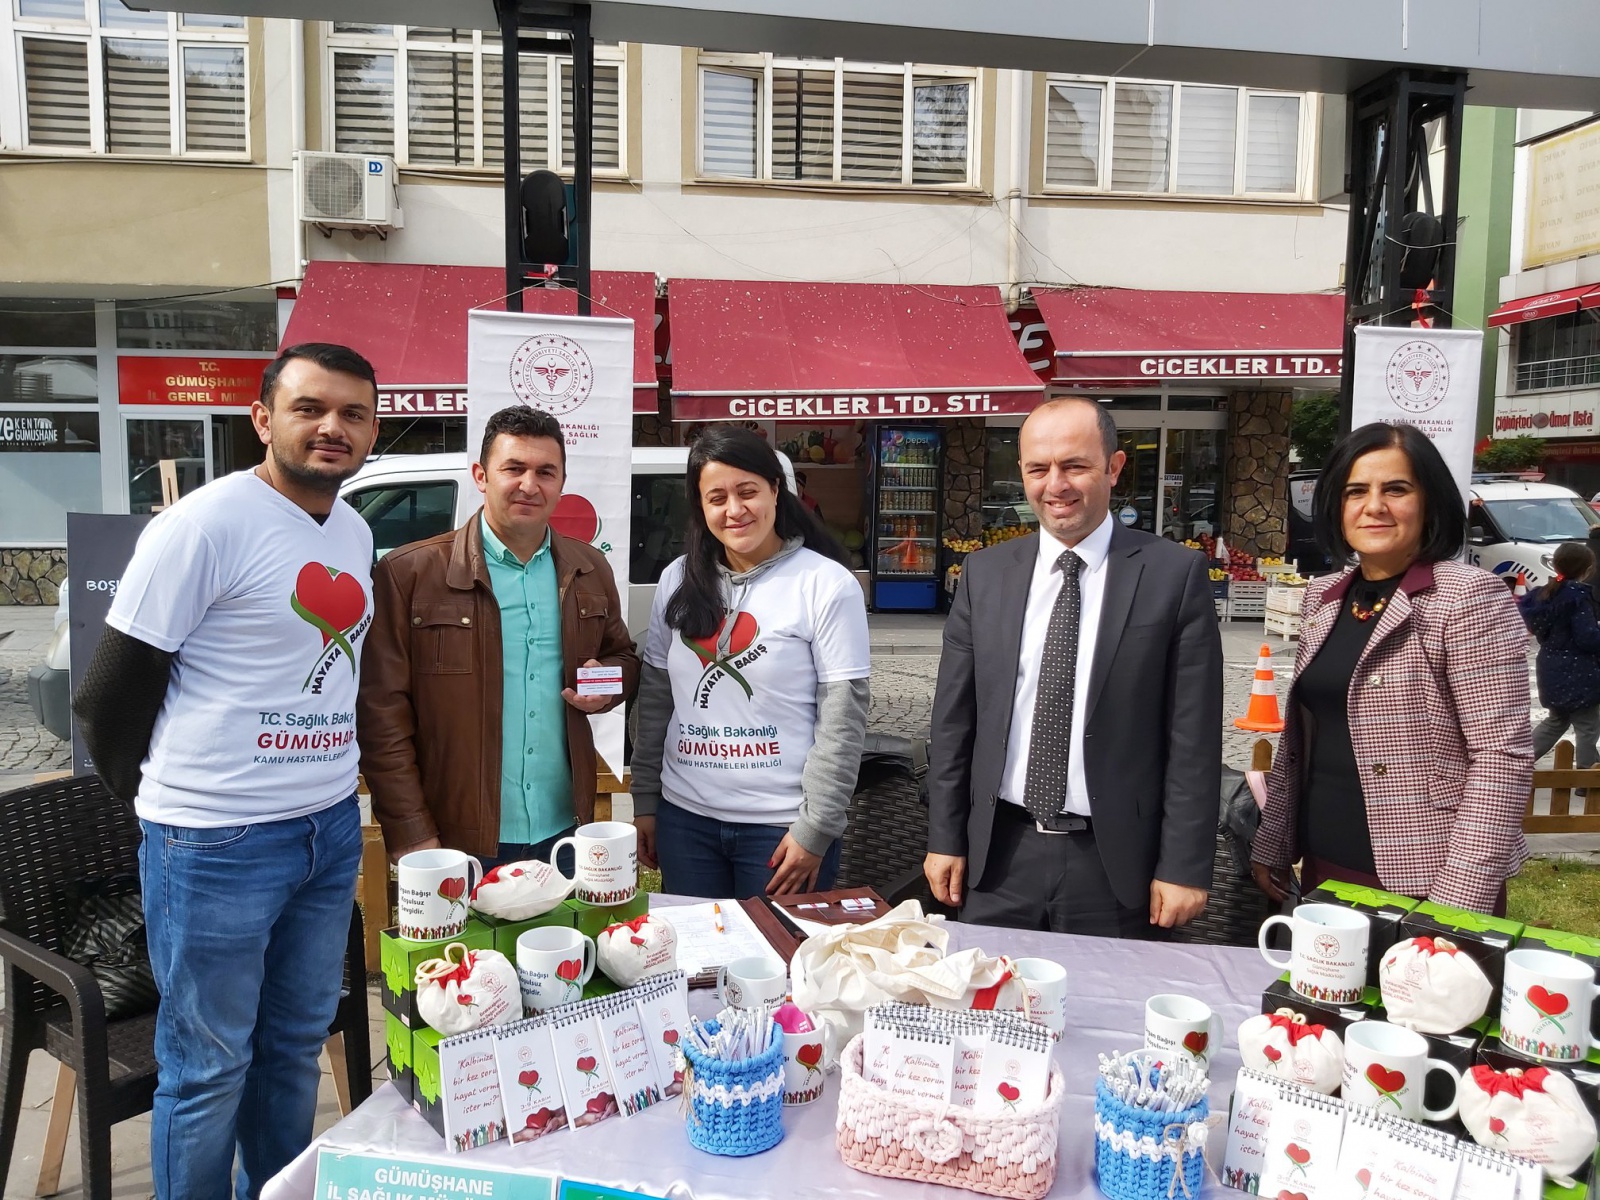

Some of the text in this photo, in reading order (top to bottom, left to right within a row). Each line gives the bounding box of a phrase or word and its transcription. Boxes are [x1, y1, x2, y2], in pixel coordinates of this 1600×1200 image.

[198, 361, 220, 372] T.C.
[1275, 357, 1331, 374] LTD.
[167, 391, 214, 402] GENEL
[377, 392, 468, 412] EKLER
[877, 396, 939, 414] LTD.
[15, 417, 37, 429] KENT
[1549, 410, 1571, 428] Ömer
[1573, 410, 1593, 426] Usta
[559, 423, 600, 431] AKANLIĞI
[568, 430, 599, 439] SAĞLIK
[905, 436, 929, 445] pepsi
[86, 580, 119, 597] BOŞ
[311, 613, 372, 694] HAYATA BAĞIŞ
[700, 643, 768, 709] HAYATA BAĞIŞ
[259, 711, 353, 730] T.C. Sağlık Baka
[687, 723, 720, 739] Sağlık
[723, 725, 778, 739] Bakanlığı
[257, 730, 354, 752] GÜMÜŞHAN
[678, 739, 781, 761] GÜMÜŞHANE
[254, 755, 285, 764] KAMU
[694, 759, 749, 770] HASTANELERİ
[751, 758, 782, 770] BİRLİĞİ
[400, 885, 432, 897] rgan Bağışı
[517, 967, 549, 980] rgan Bağışı
[520, 987, 542, 997] evgidir.
[632, 1036, 645, 1046] soru
[633, 1049, 648, 1060] verme
[961, 1050, 983, 1060] "Kalbi
[480, 1068, 497, 1078] soru
[894, 1069, 907, 1079] bir
[908, 1072, 920, 1082] kez
[954, 1066, 980, 1076] bir kez
[479, 1083, 500, 1093] verme
[892, 1085, 915, 1097] hayat
[1247, 1096, 1273, 1111] "Kalbi
[1237, 1110, 1265, 1126] bir kez
[1234, 1125, 1259, 1140] hayat
[374, 1165, 494, 1197] GÜMÜŞHANE
[327, 1181, 342, 1200] İL
